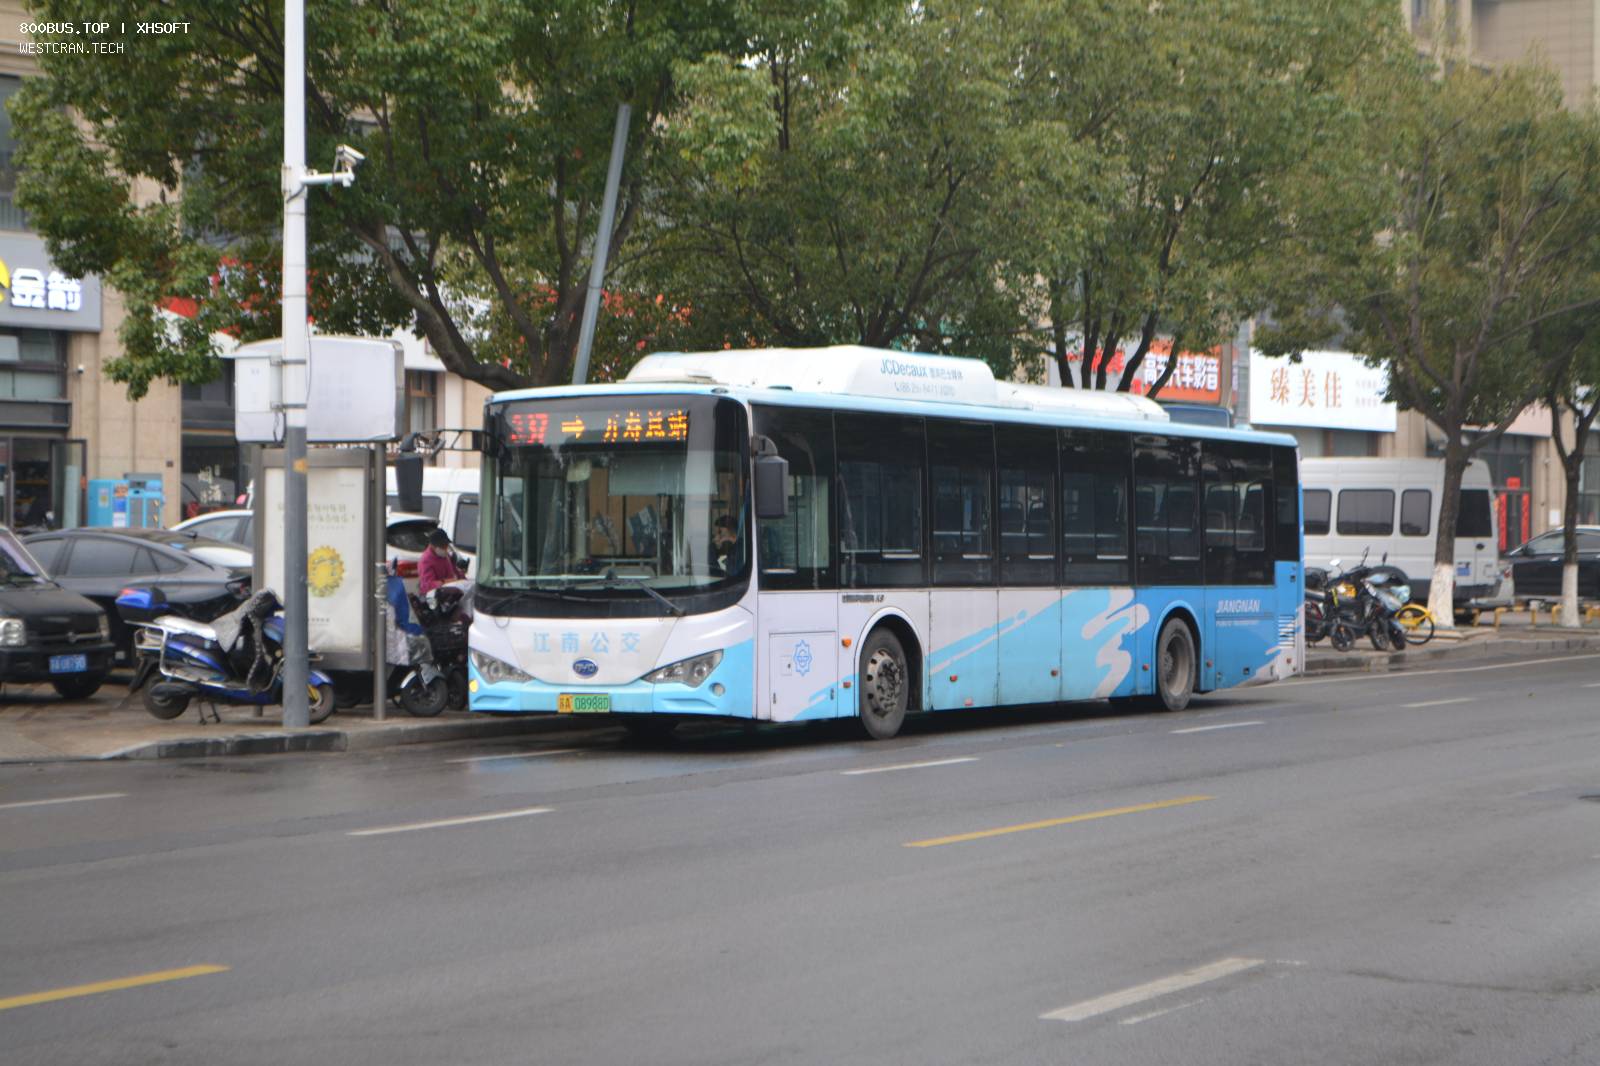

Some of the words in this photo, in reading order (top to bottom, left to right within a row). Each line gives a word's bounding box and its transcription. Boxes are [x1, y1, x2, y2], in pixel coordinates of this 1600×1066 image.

[880, 358, 929, 378] JCDecaux
[1269, 366, 1343, 408] 臻美佳
[1216, 599, 1261, 613] JIANGNAN
[533, 630, 641, 654] 江南公交
